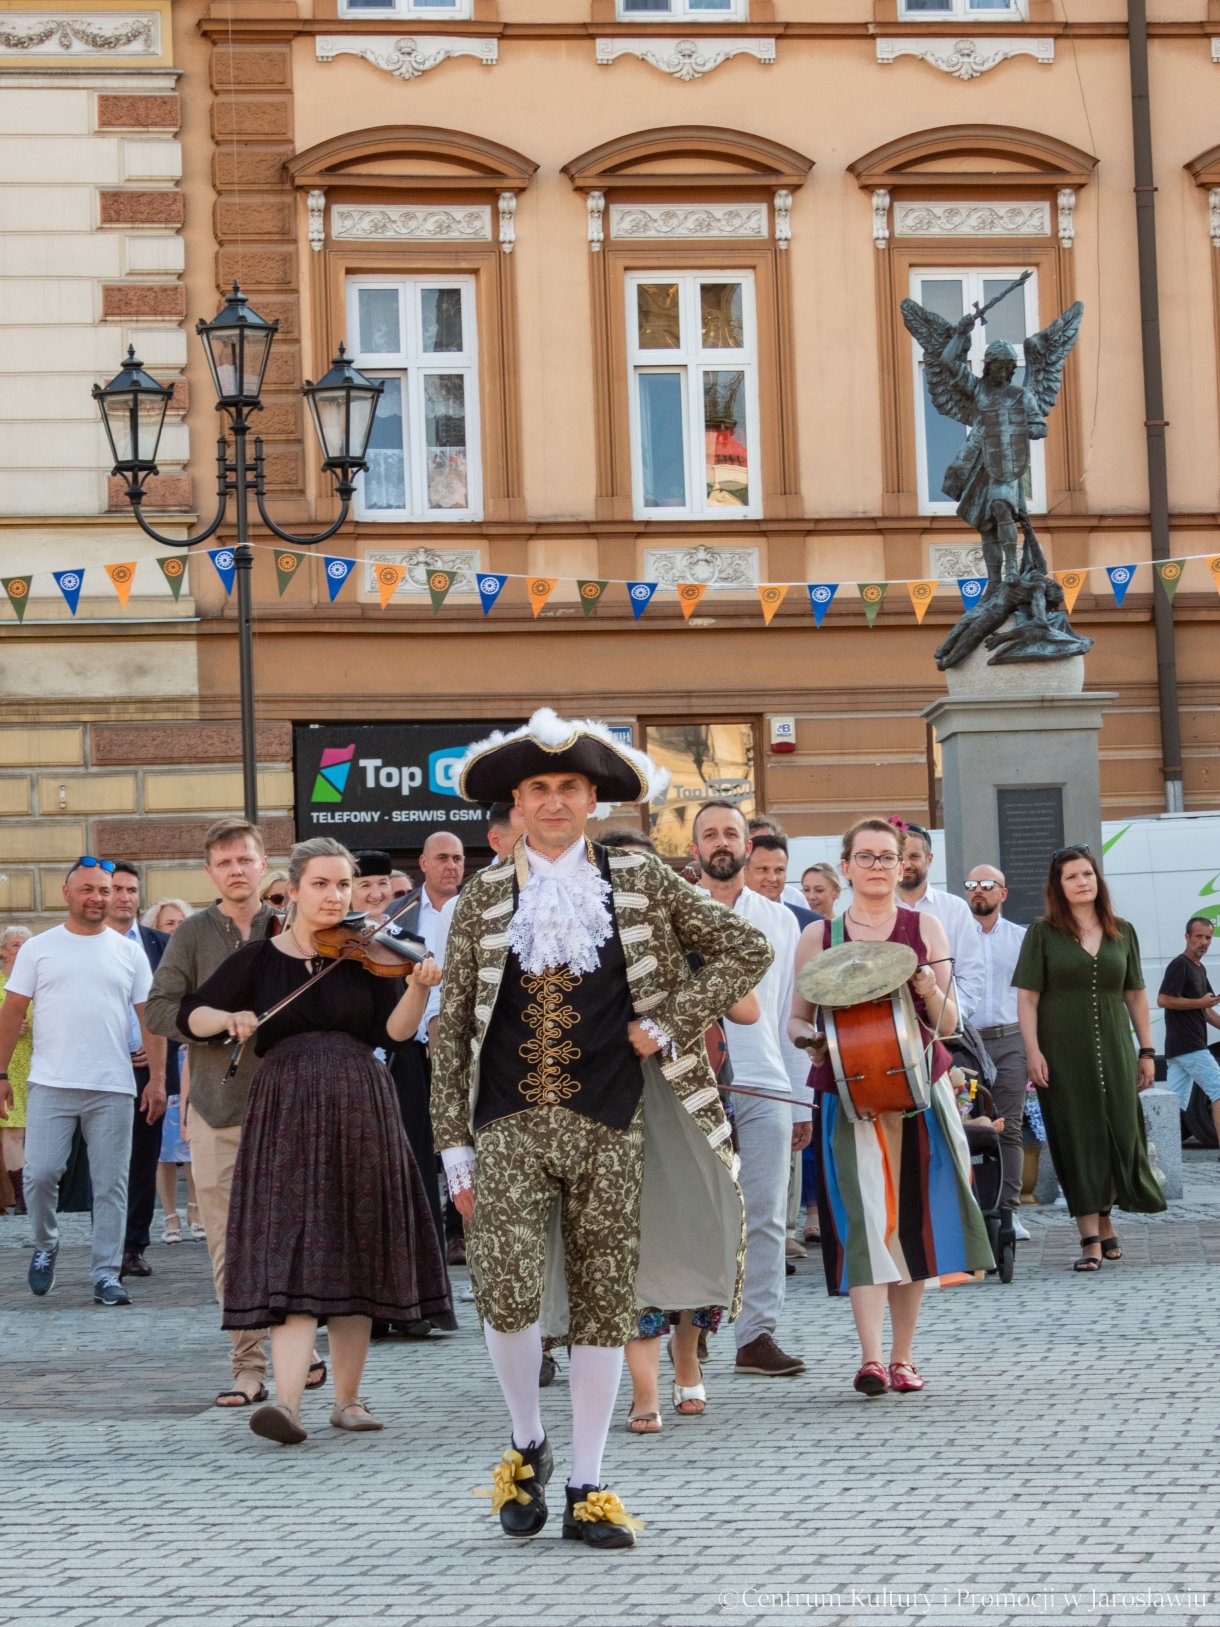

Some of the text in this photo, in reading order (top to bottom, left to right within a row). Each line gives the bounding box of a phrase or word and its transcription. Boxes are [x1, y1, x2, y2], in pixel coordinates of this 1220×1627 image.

[359, 759, 422, 795] Top
[673, 784, 703, 800] Top
[310, 811, 381, 823] TELEFONY
[392, 810, 446, 822] SERWIS
[449, 809, 482, 821] GSM
